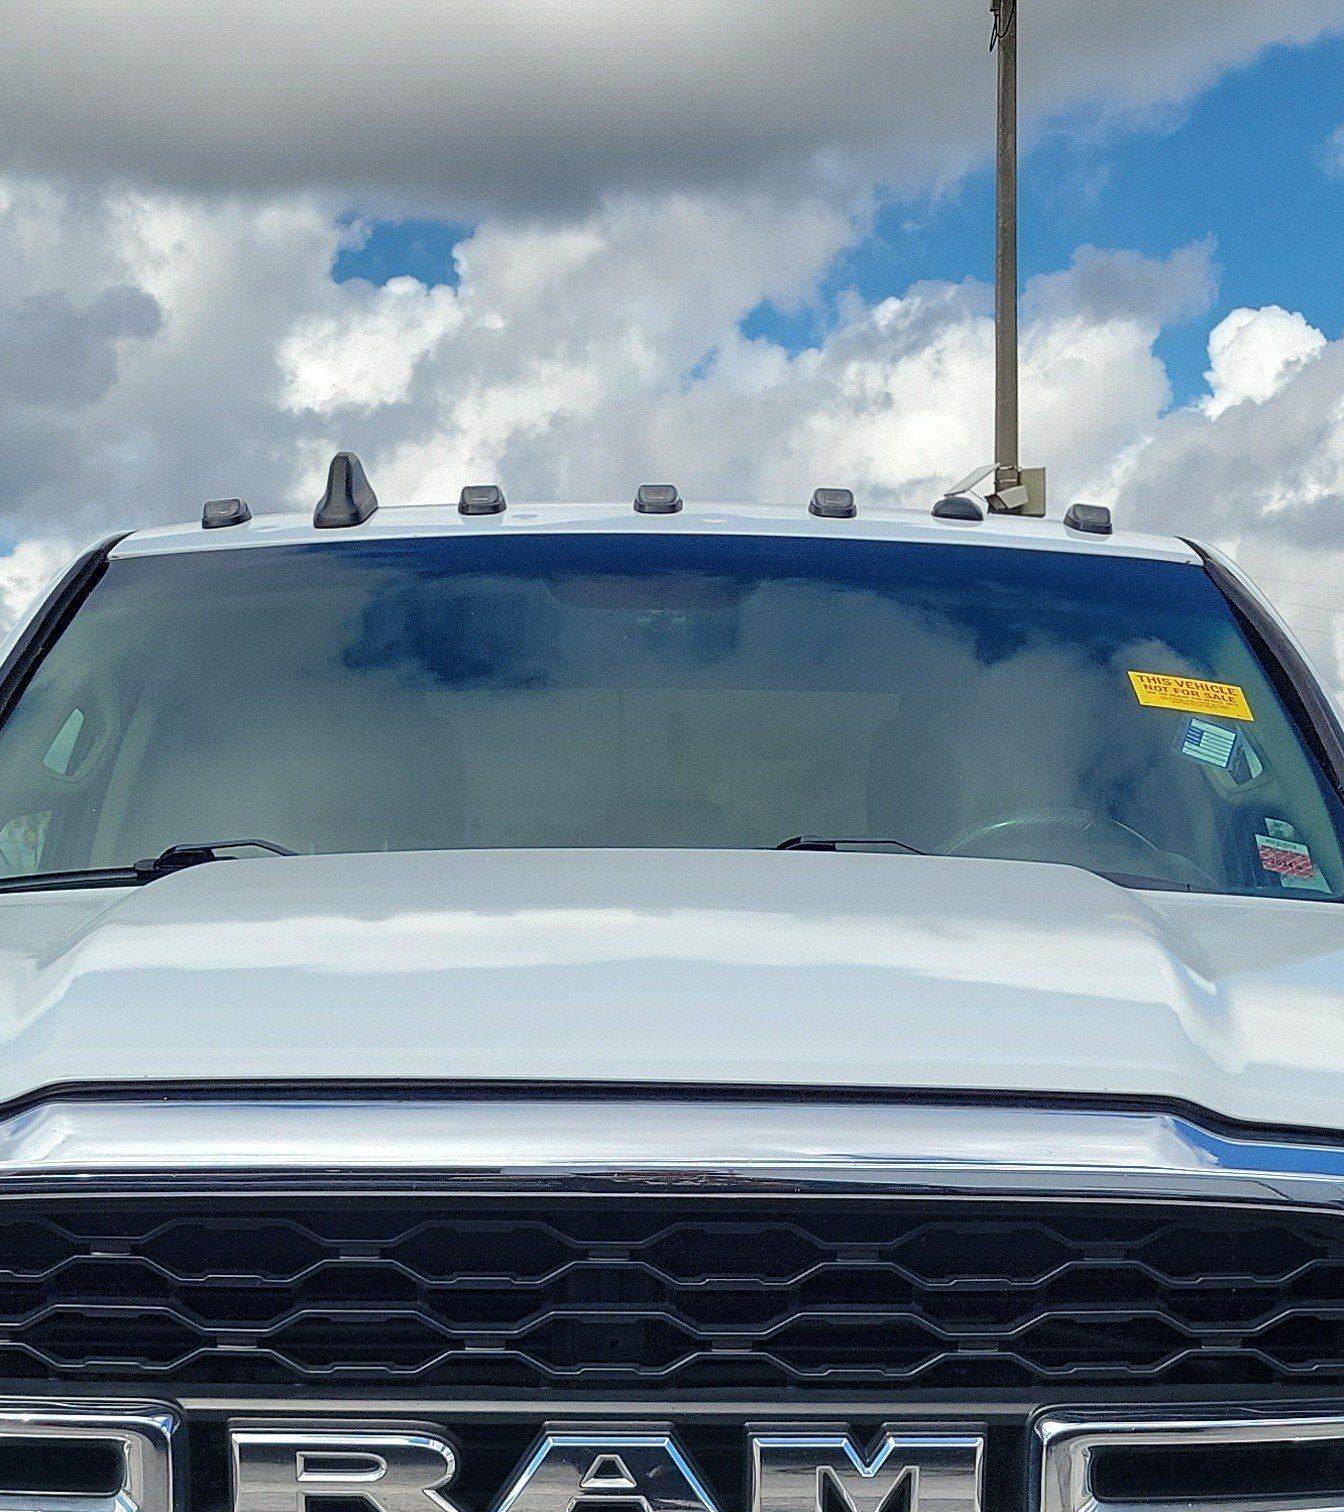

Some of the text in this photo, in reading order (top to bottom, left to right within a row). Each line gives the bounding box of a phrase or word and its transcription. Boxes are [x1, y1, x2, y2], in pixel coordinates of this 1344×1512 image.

[1137, 675, 1238, 696] THIS VEHICLE
[1144, 683, 1169, 693] NOT
[1173, 686, 1200, 697] FOR
[1204, 692, 1237, 703] SALE
